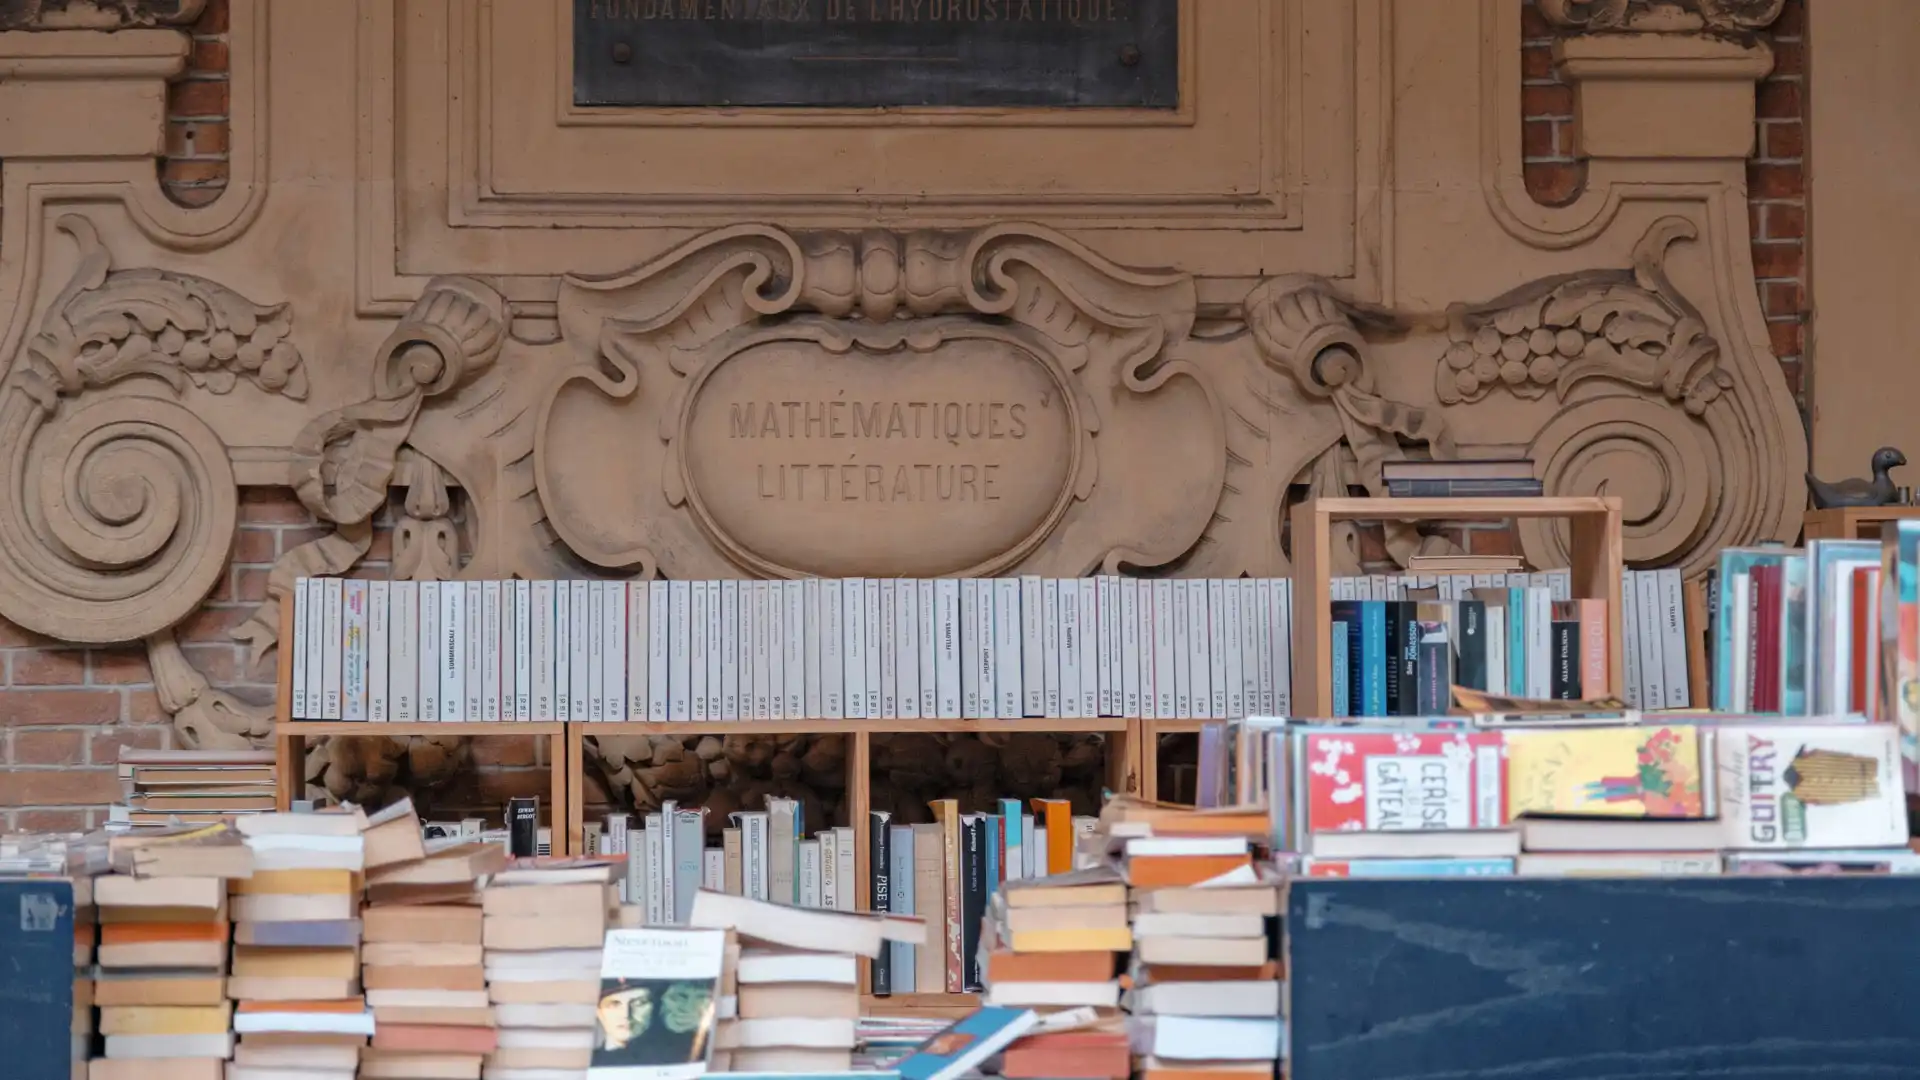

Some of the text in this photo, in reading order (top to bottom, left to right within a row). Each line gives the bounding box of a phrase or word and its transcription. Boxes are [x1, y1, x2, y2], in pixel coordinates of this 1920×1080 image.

[729, 389, 1027, 447] MATHÉMATIQUES
[757, 453, 1001, 501] LITTÉRATURE
[1748, 733, 1777, 844] GUITRY
[877, 874, 887, 905] PISE
